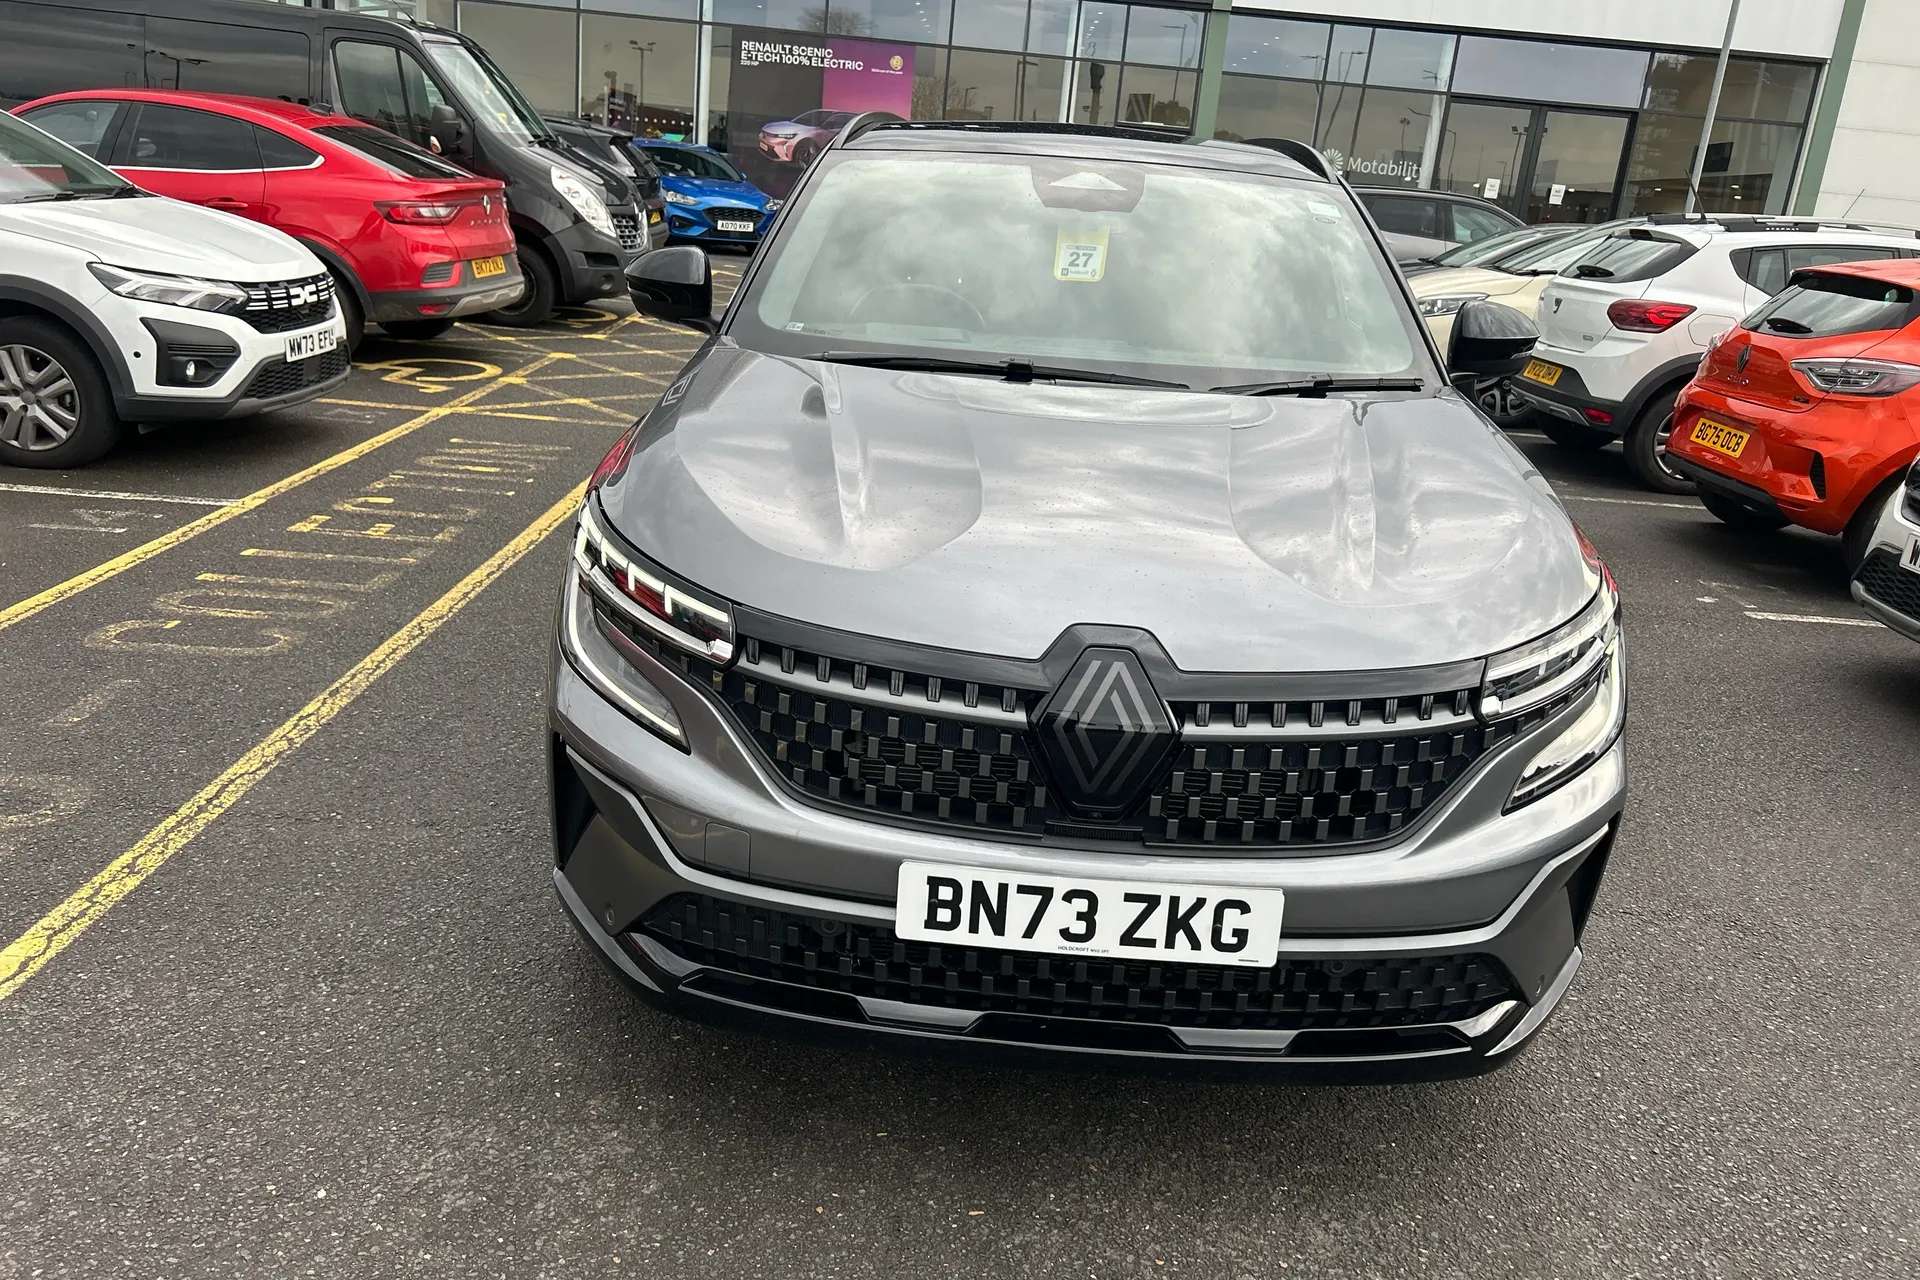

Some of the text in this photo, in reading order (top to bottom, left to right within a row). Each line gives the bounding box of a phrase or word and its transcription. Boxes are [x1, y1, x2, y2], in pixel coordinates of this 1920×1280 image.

[740, 51, 864, 71] E-TECH 100% ELECTRIC
[741, 40, 834, 58] RENAULT SCENIC
[1068, 251, 1094, 267] 27
[289, 334, 315, 358] MW73
[1695, 422, 1744, 453] BG75 OCB
[84, 438, 571, 656] COLLECTION
[924, 875, 1251, 953] BN73 ZKG
